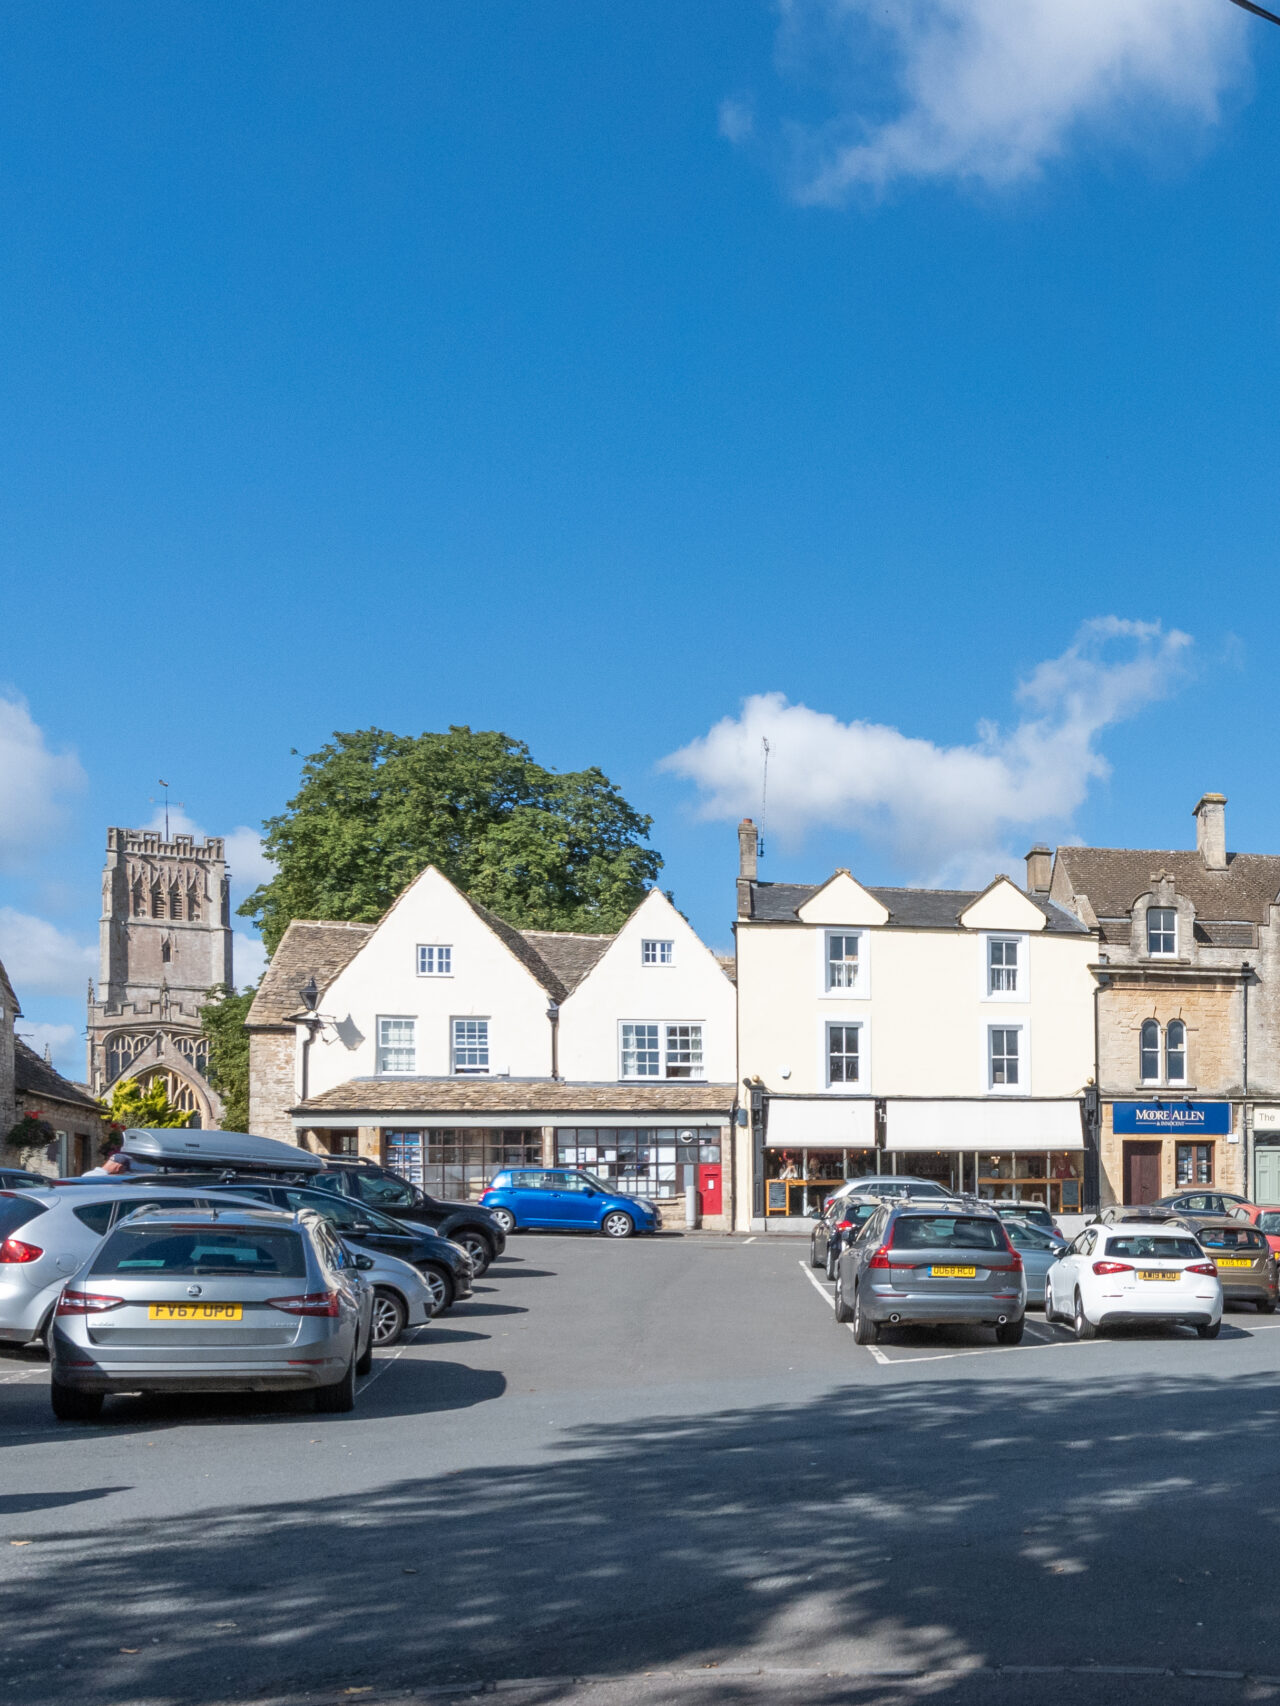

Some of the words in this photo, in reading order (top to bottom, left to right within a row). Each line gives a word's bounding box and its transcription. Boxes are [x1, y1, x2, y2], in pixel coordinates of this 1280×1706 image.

[1135, 1109, 1170, 1120] MOORE
[1171, 1110, 1205, 1121] ALLEN
[1259, 1113, 1275, 1122] The
[155, 1303, 198, 1317] FV67
[203, 1304, 235, 1318] UPO
